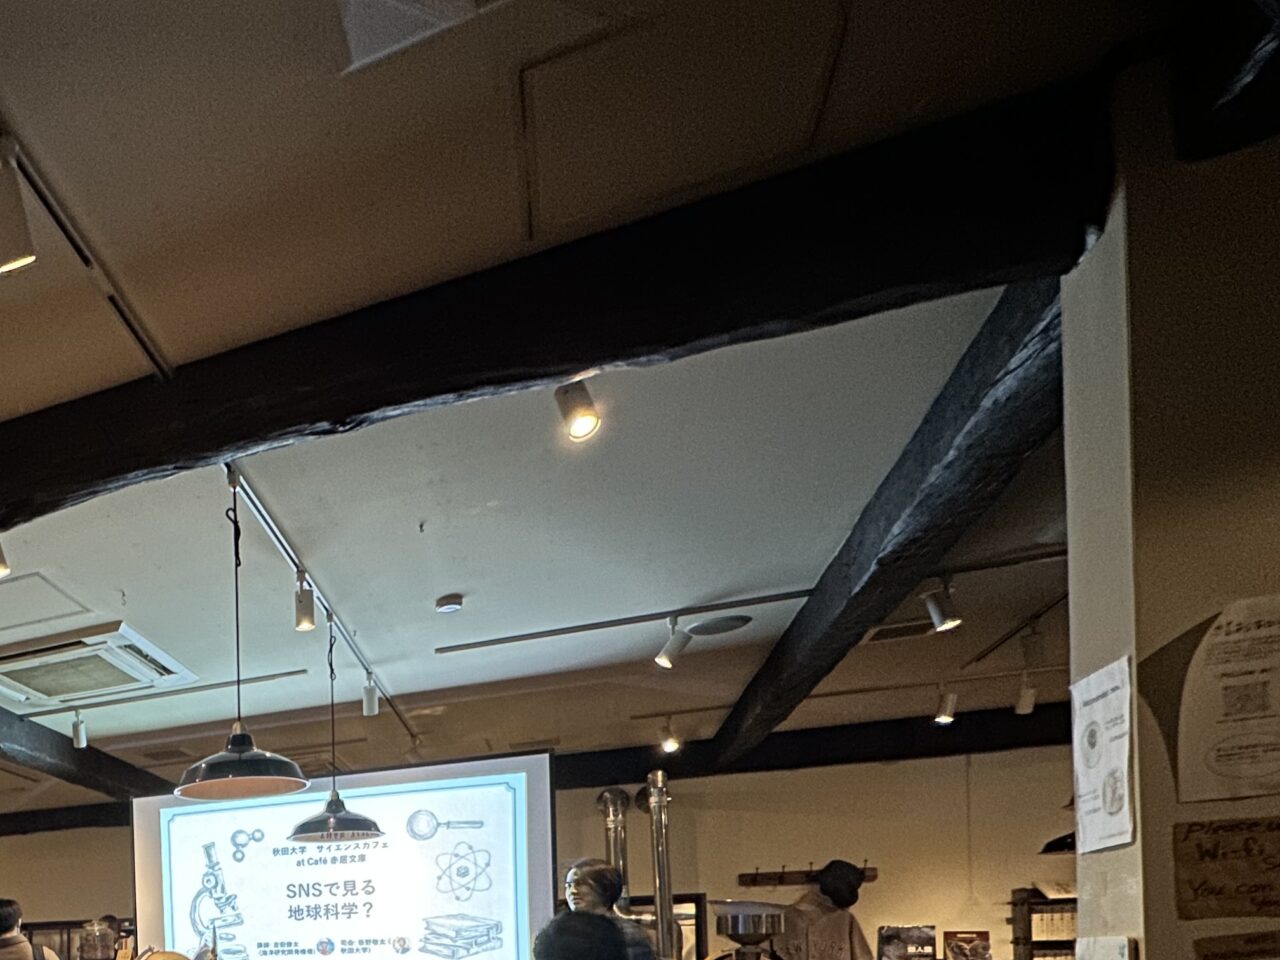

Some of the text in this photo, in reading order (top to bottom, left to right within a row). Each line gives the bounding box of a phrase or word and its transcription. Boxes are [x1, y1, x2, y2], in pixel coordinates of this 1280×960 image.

[272, 841, 389, 856] 秋田大学 サイエンスカフェ
[296, 858, 305, 867] at
[307, 856, 328, 866] Café
[286, 879, 376, 898] SNSで見る
[287, 901, 374, 921] 地球科学？
